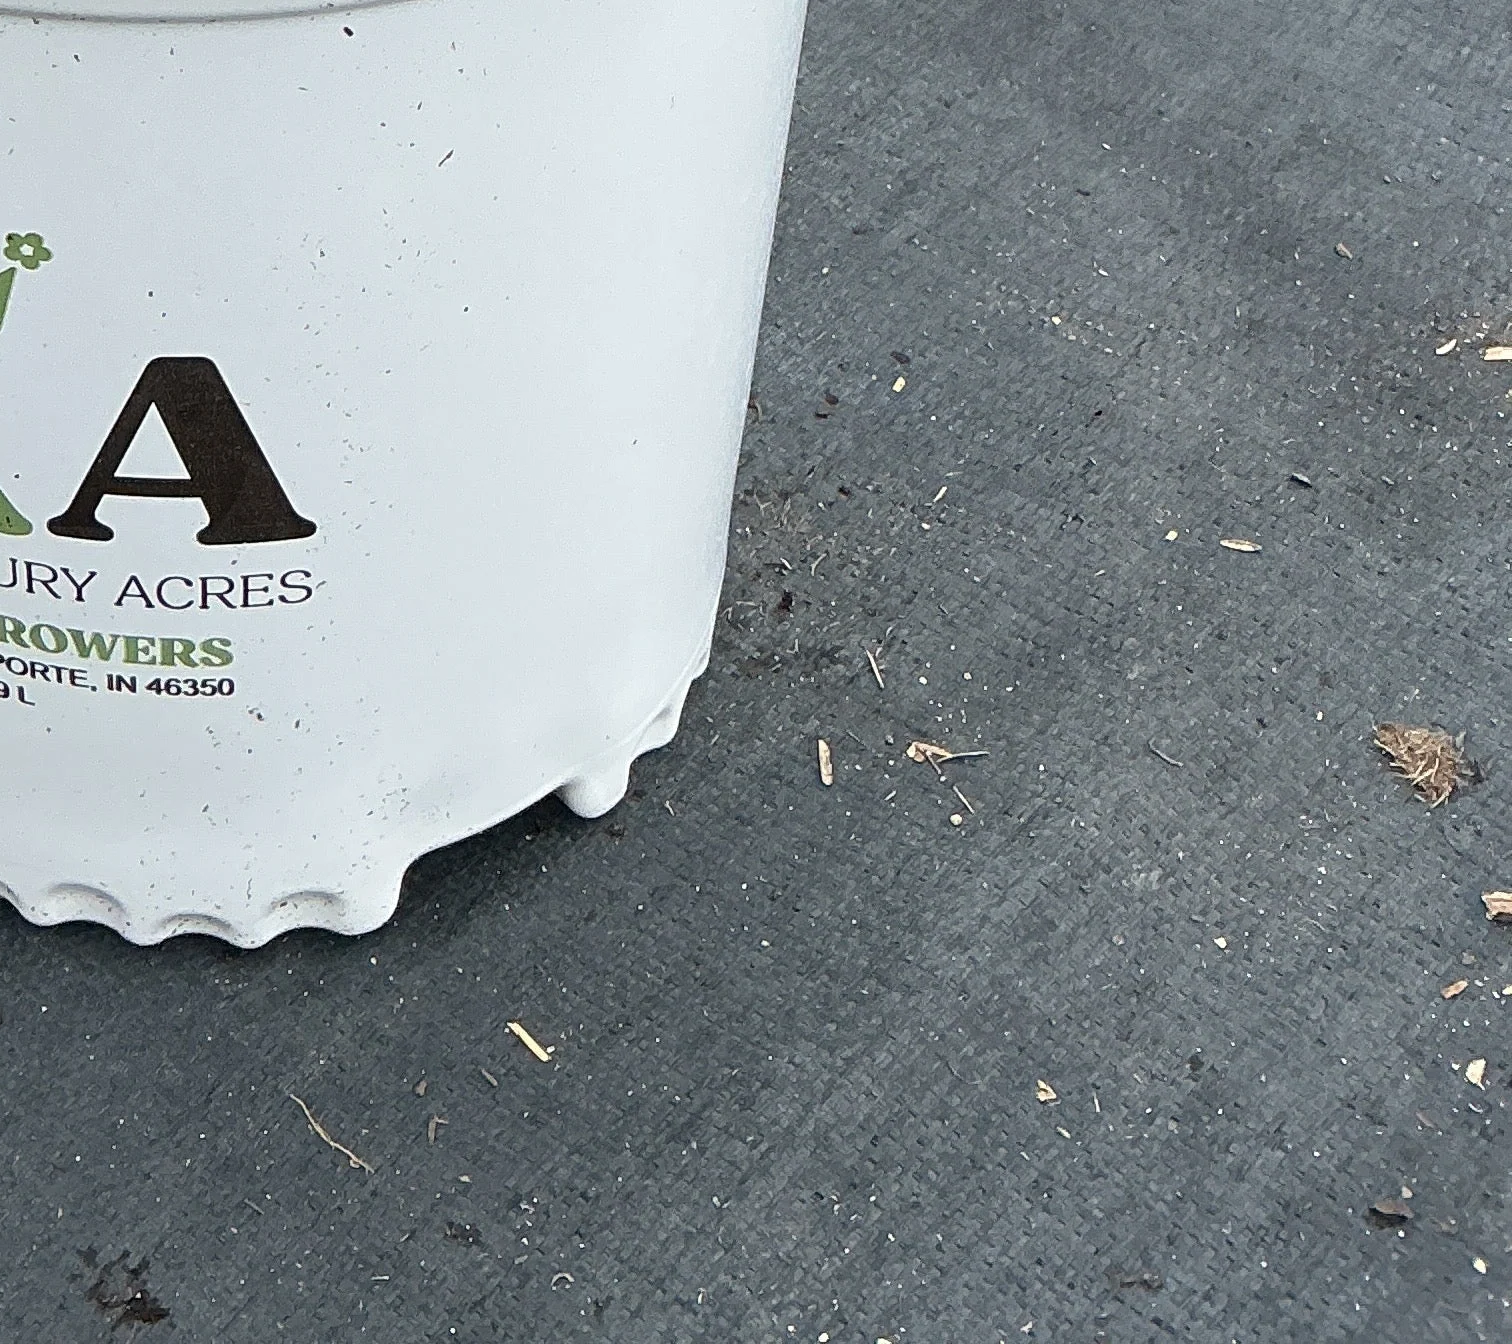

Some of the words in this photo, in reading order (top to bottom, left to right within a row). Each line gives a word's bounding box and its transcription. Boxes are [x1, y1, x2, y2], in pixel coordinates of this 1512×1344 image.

[113, 569, 315, 611] ACRES
[18, 685, 37, 707] L
[106, 673, 137, 695] IN
[145, 677, 236, 698] 46350
